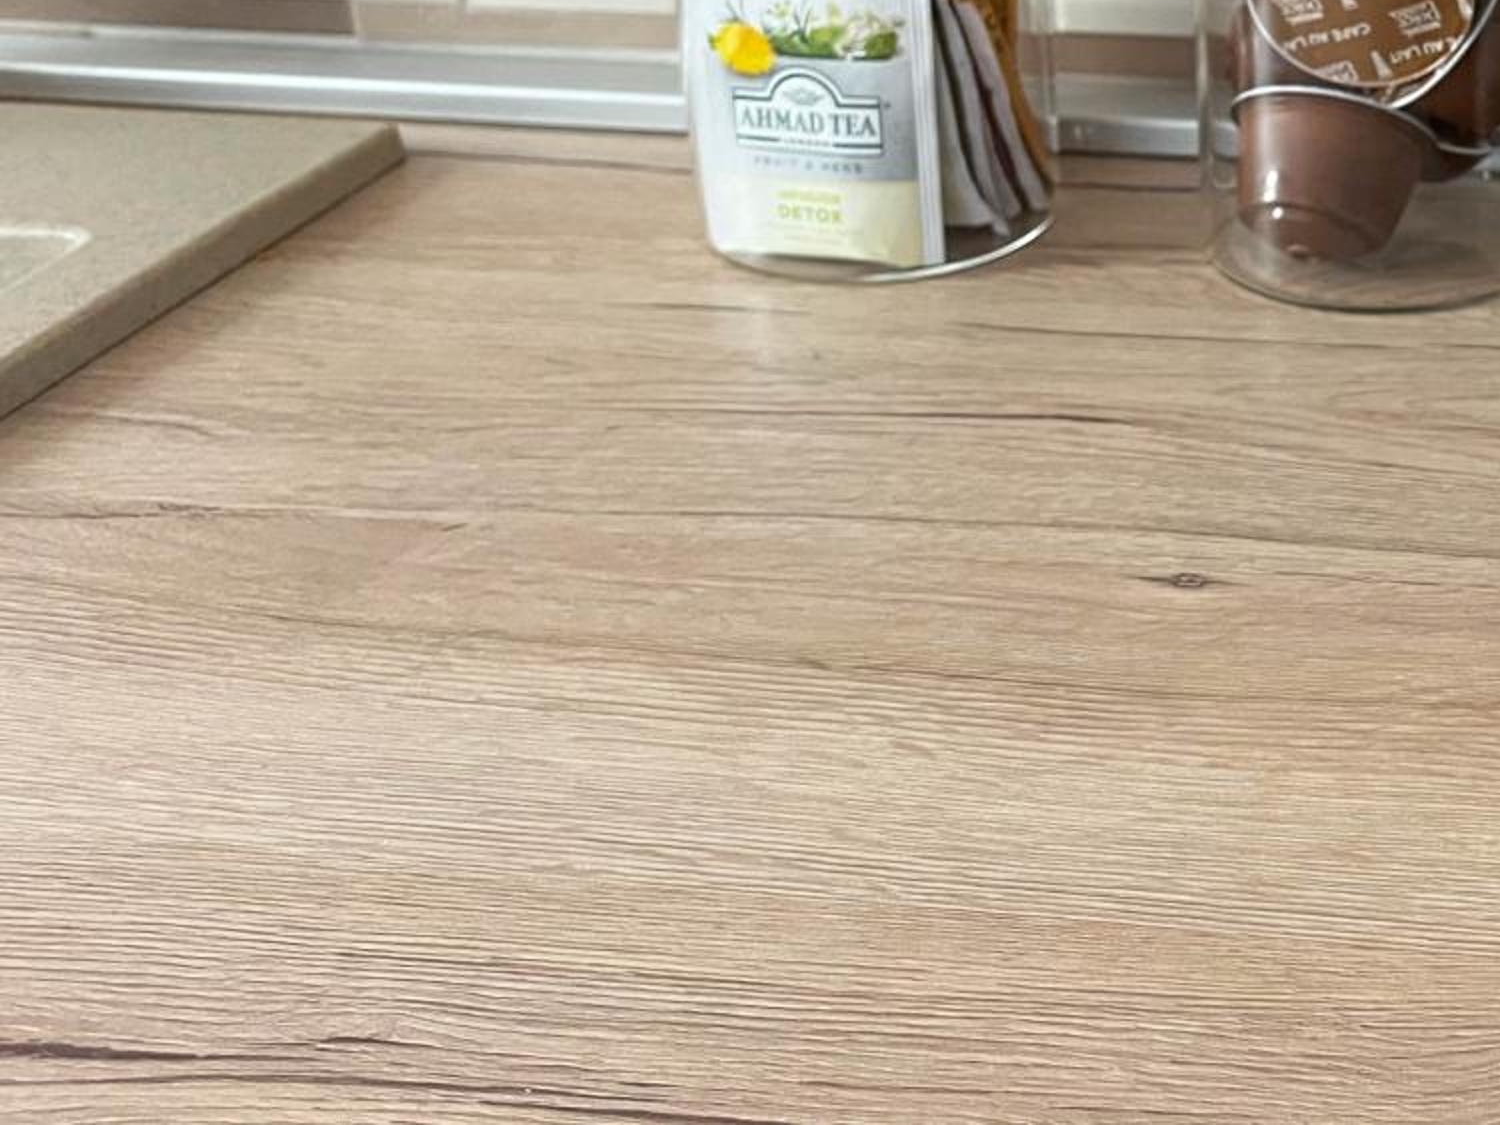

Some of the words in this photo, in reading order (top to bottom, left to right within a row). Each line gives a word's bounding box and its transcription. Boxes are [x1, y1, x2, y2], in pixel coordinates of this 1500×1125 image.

[741, 106, 824, 134] AHMAD
[828, 112, 876, 136] TEA
[776, 203, 843, 223] DETOX
